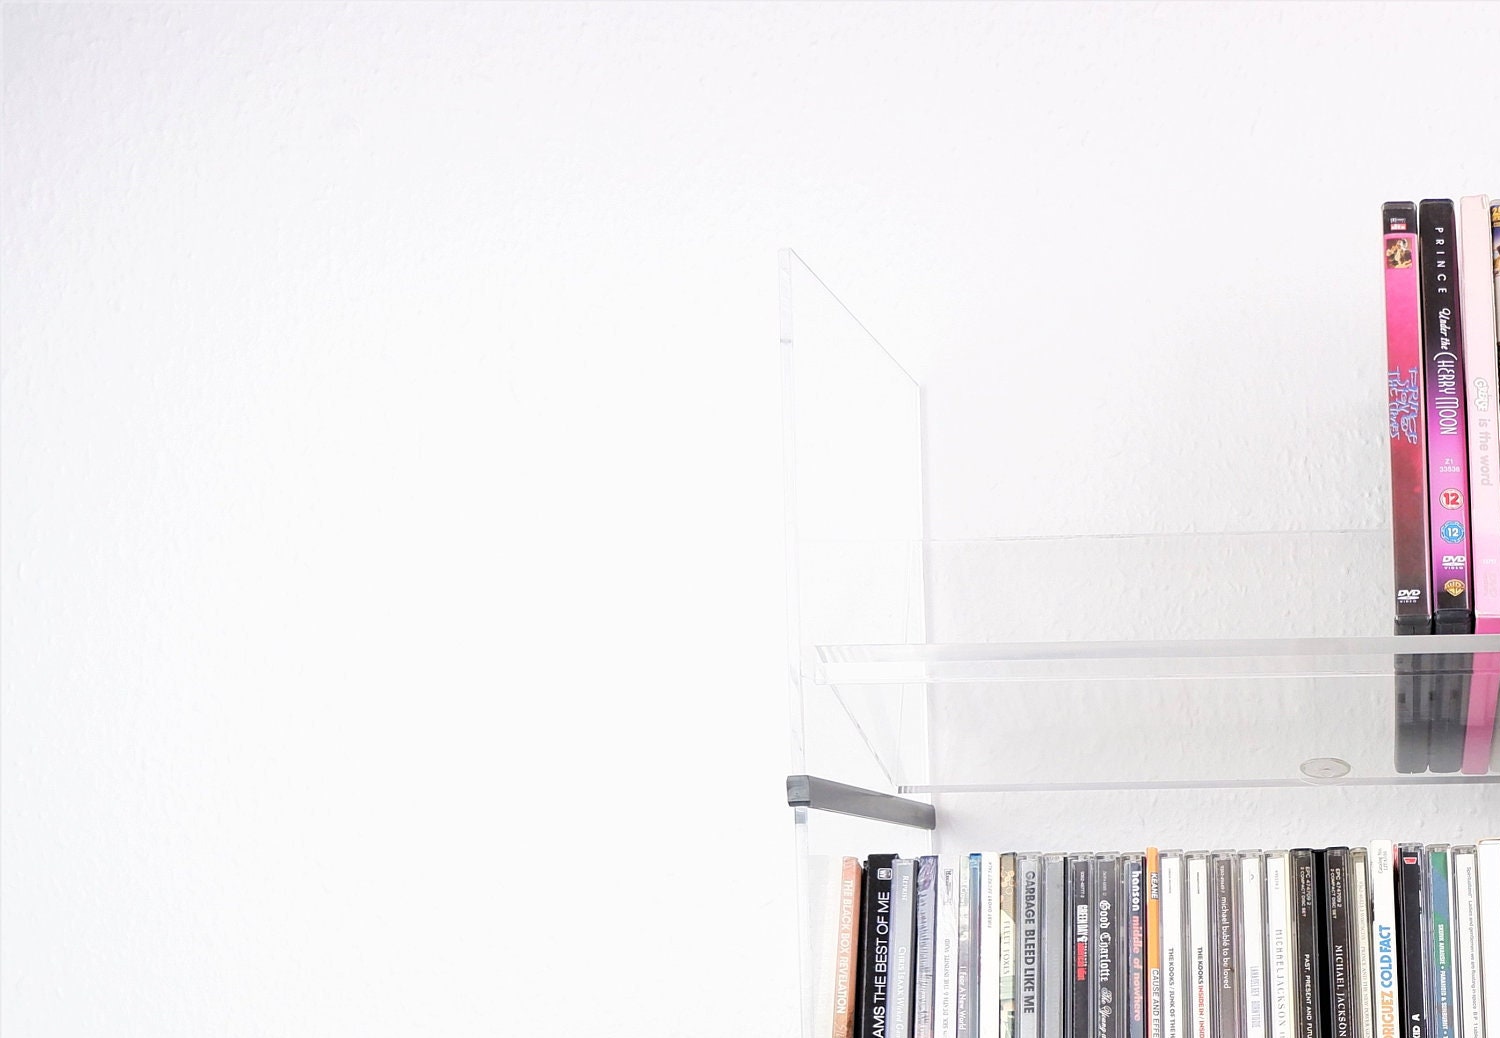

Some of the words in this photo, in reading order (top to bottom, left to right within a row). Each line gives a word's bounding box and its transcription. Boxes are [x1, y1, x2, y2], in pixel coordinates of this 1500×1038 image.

[1434, 227, 1447, 293] PRINCE
[1438, 308, 1451, 336] Under
[1440, 336, 1450, 350] the
[1434, 352, 1457, 394] CHERRY
[1435, 397, 1458, 435] MOON
[1443, 492, 1460, 506] 12
[1447, 528, 1459, 537] 12
[843, 880, 853, 896] THE
[878, 892, 890, 912] ME
[1024, 870, 1036, 924] GARBAGE
[1132, 870, 1142, 912] hanson
[841, 899, 852, 931] BLACK
[877, 916, 889, 934] OF
[1100, 900, 1112, 928] Good
[840, 933, 850, 954] BOX
[1024, 929, 1036, 966] BLEED
[1133, 916, 1142, 954] middle
[1222, 926, 1230, 946] bublé
[1378, 924, 1392, 952] FACT
[875, 938, 888, 972] BEST
[1099, 932, 1112, 982] Charlotte
[1133, 957, 1142, 970] of
[1222, 948, 1229, 956] to
[1223, 957, 1230, 967] be
[1024, 968, 1035, 992] LIKE
[1223, 968, 1231, 989] loved
[1335, 945, 1345, 989] MICHAEL
[1380, 955, 1393, 988] COLD
[837, 956, 849, 1014] REVELATION
[874, 976, 886, 1004] THE
[1133, 972, 1143, 1021] nowhere
[1152, 970, 1160, 996] CAUSE
[1024, 996, 1035, 1014] ME
[1336, 992, 1347, 1037] JACKSON
